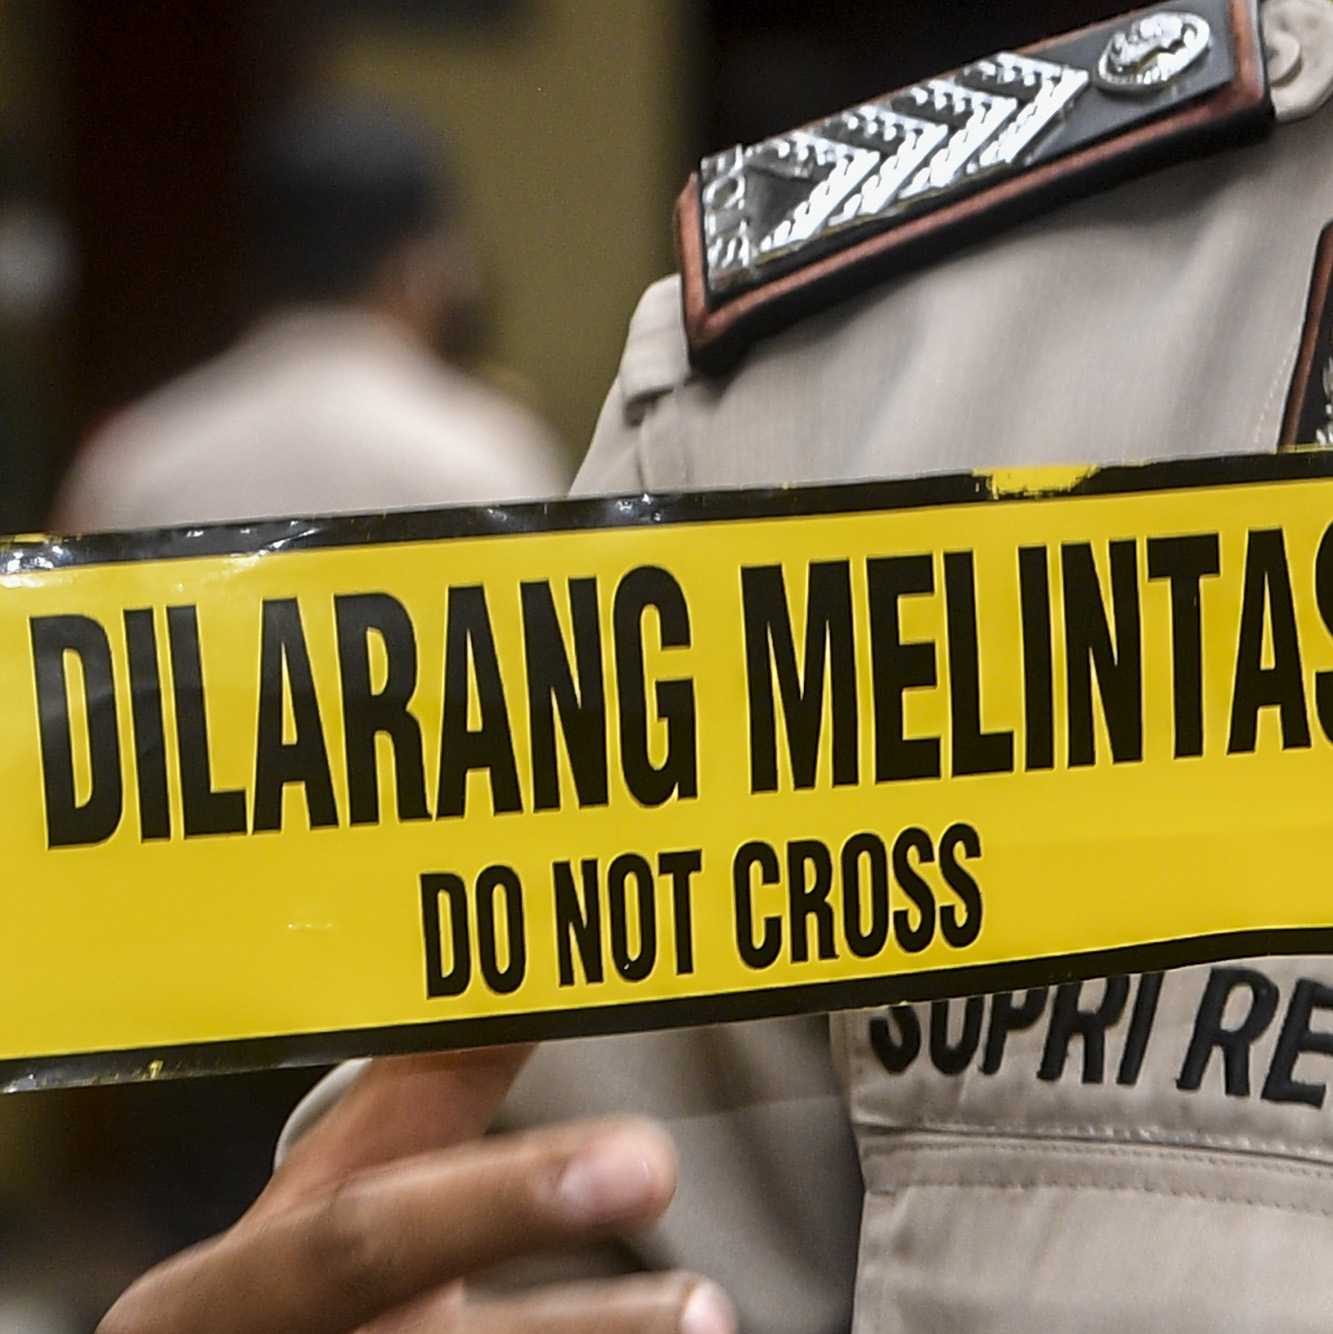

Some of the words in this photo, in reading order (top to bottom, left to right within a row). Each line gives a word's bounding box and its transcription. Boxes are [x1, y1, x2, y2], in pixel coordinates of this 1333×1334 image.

[29, 565, 699, 849] DILARANG
[419, 864, 527, 999] DO
[552, 849, 703, 987] NOT
[732, 822, 982, 970] CROSS
